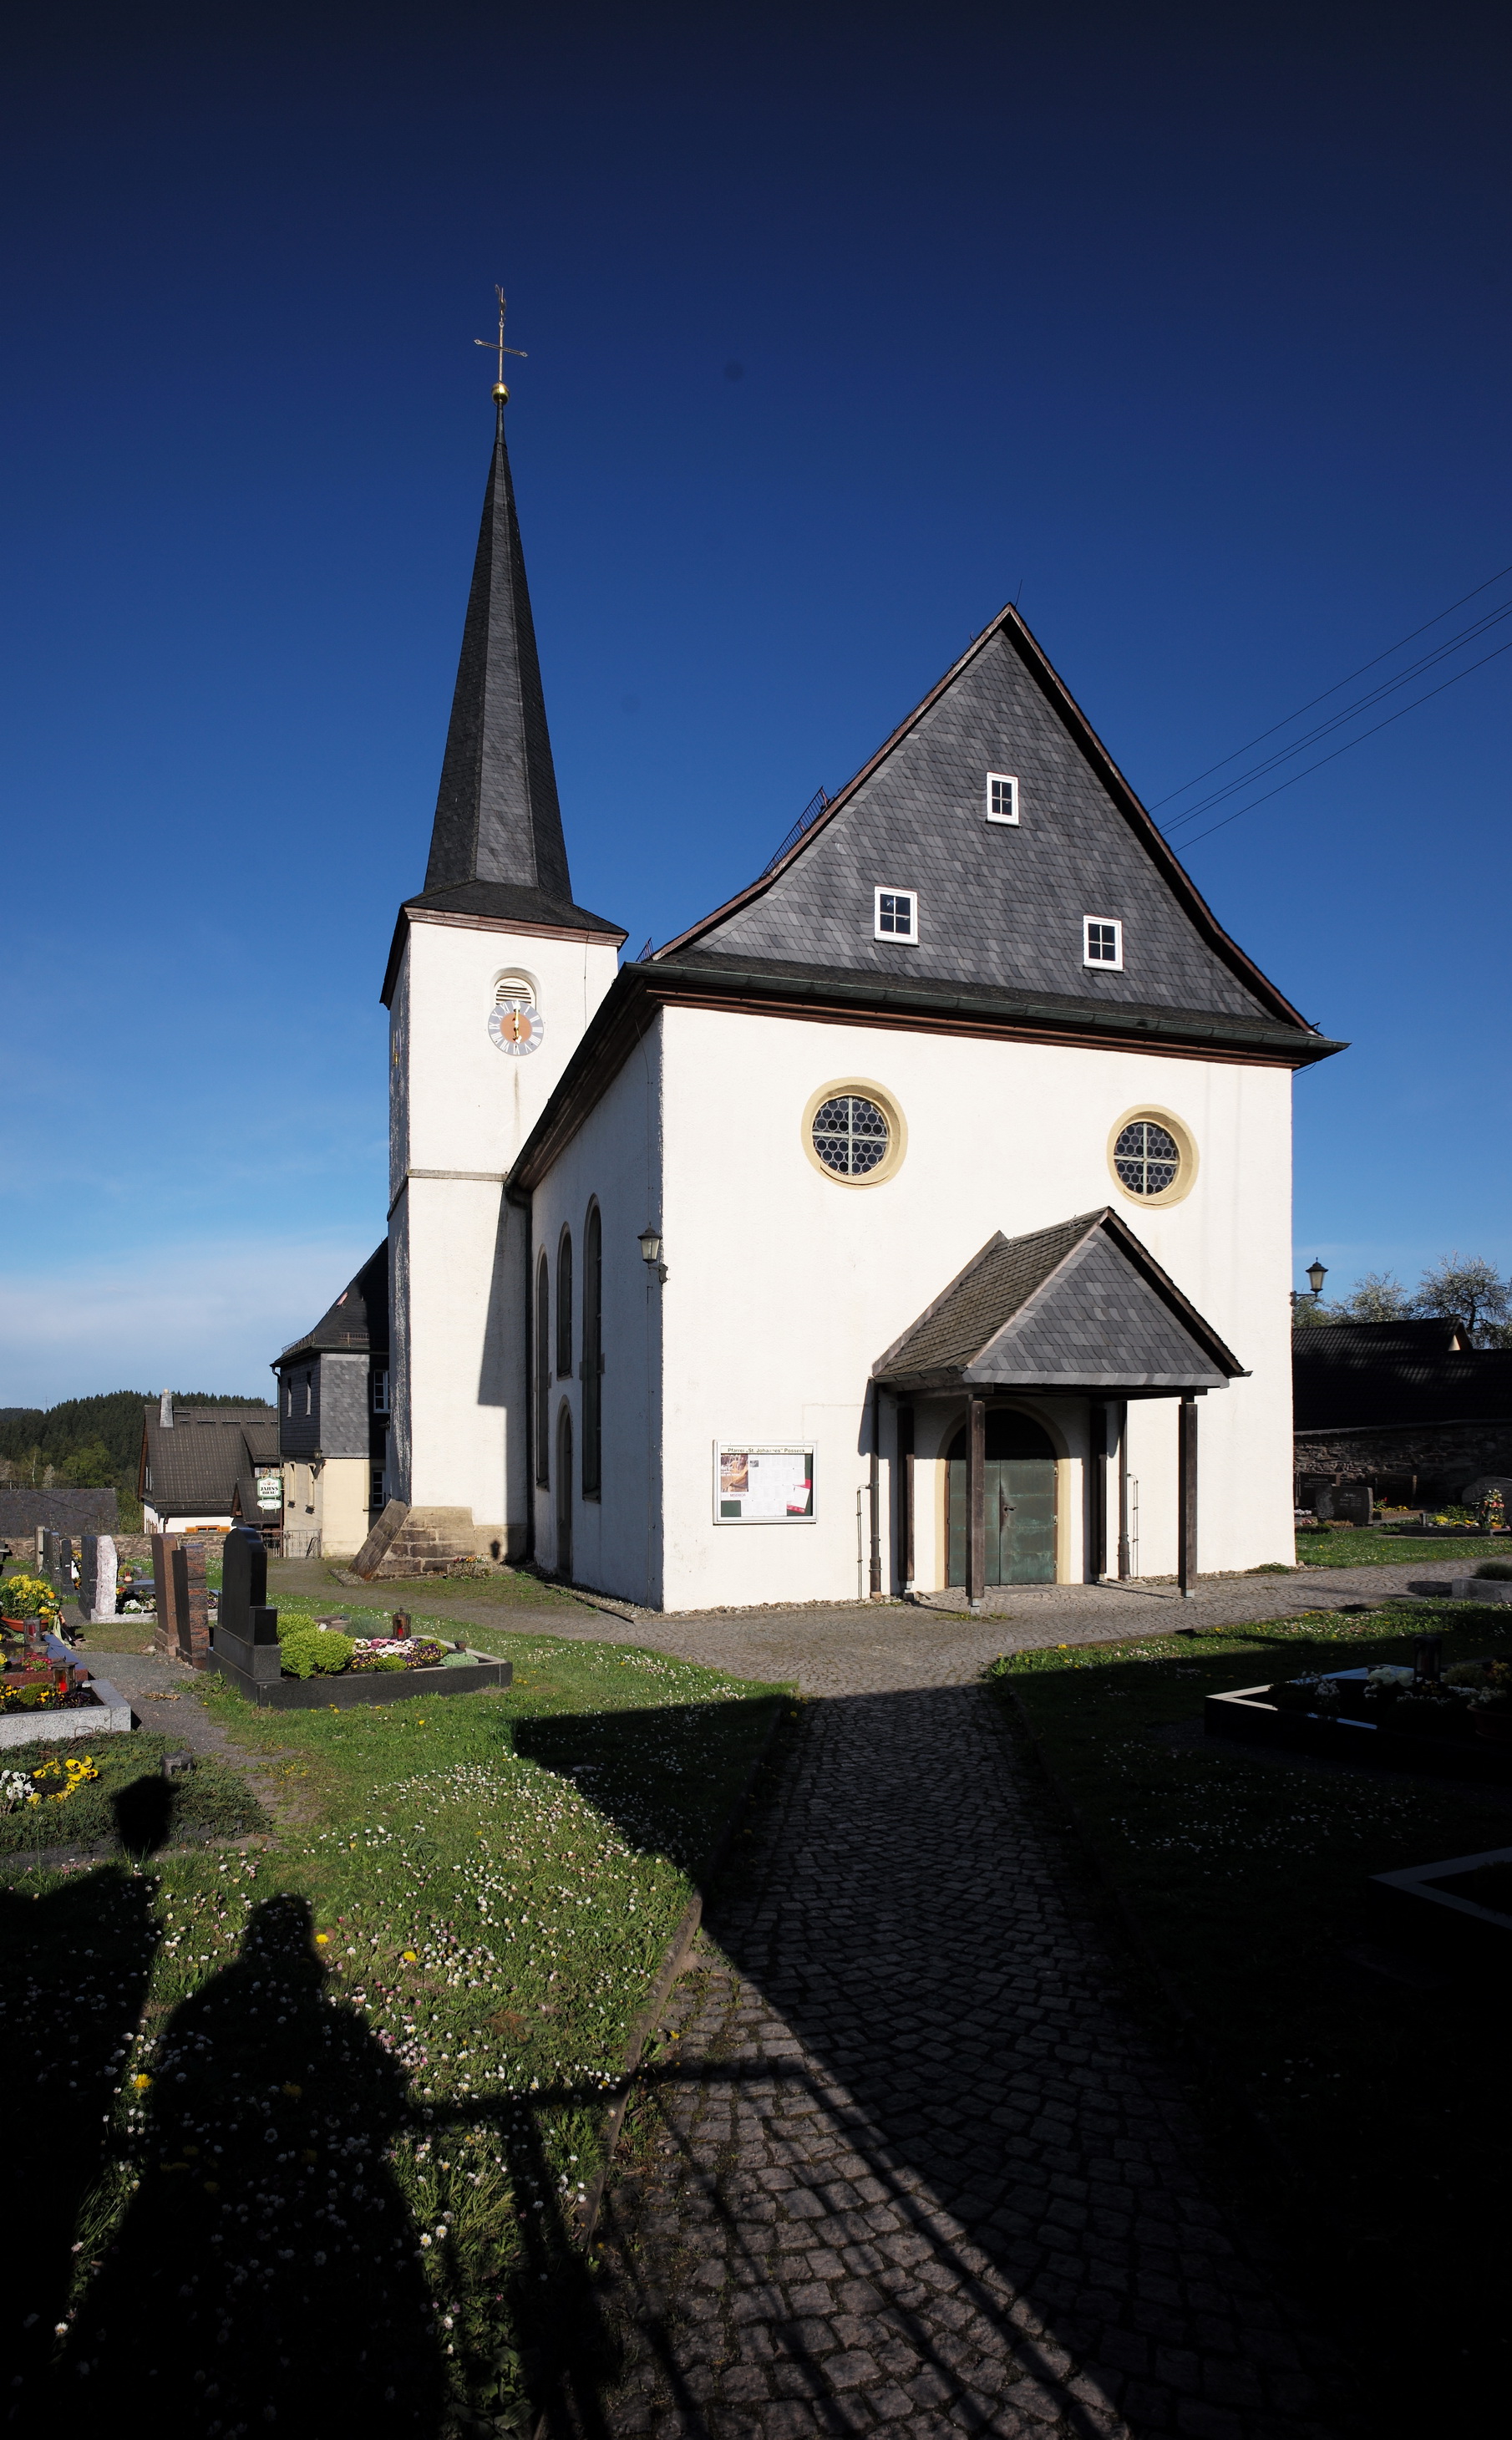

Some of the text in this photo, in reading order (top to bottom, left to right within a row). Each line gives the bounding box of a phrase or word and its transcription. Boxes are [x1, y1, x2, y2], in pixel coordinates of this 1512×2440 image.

[491, 1010, 503, 1020] X
[523, 1005, 530, 1015] I
[529, 1014, 540, 1023] II
[489, 1021, 500, 1029] IX
[524, 1043, 532, 1053] V
